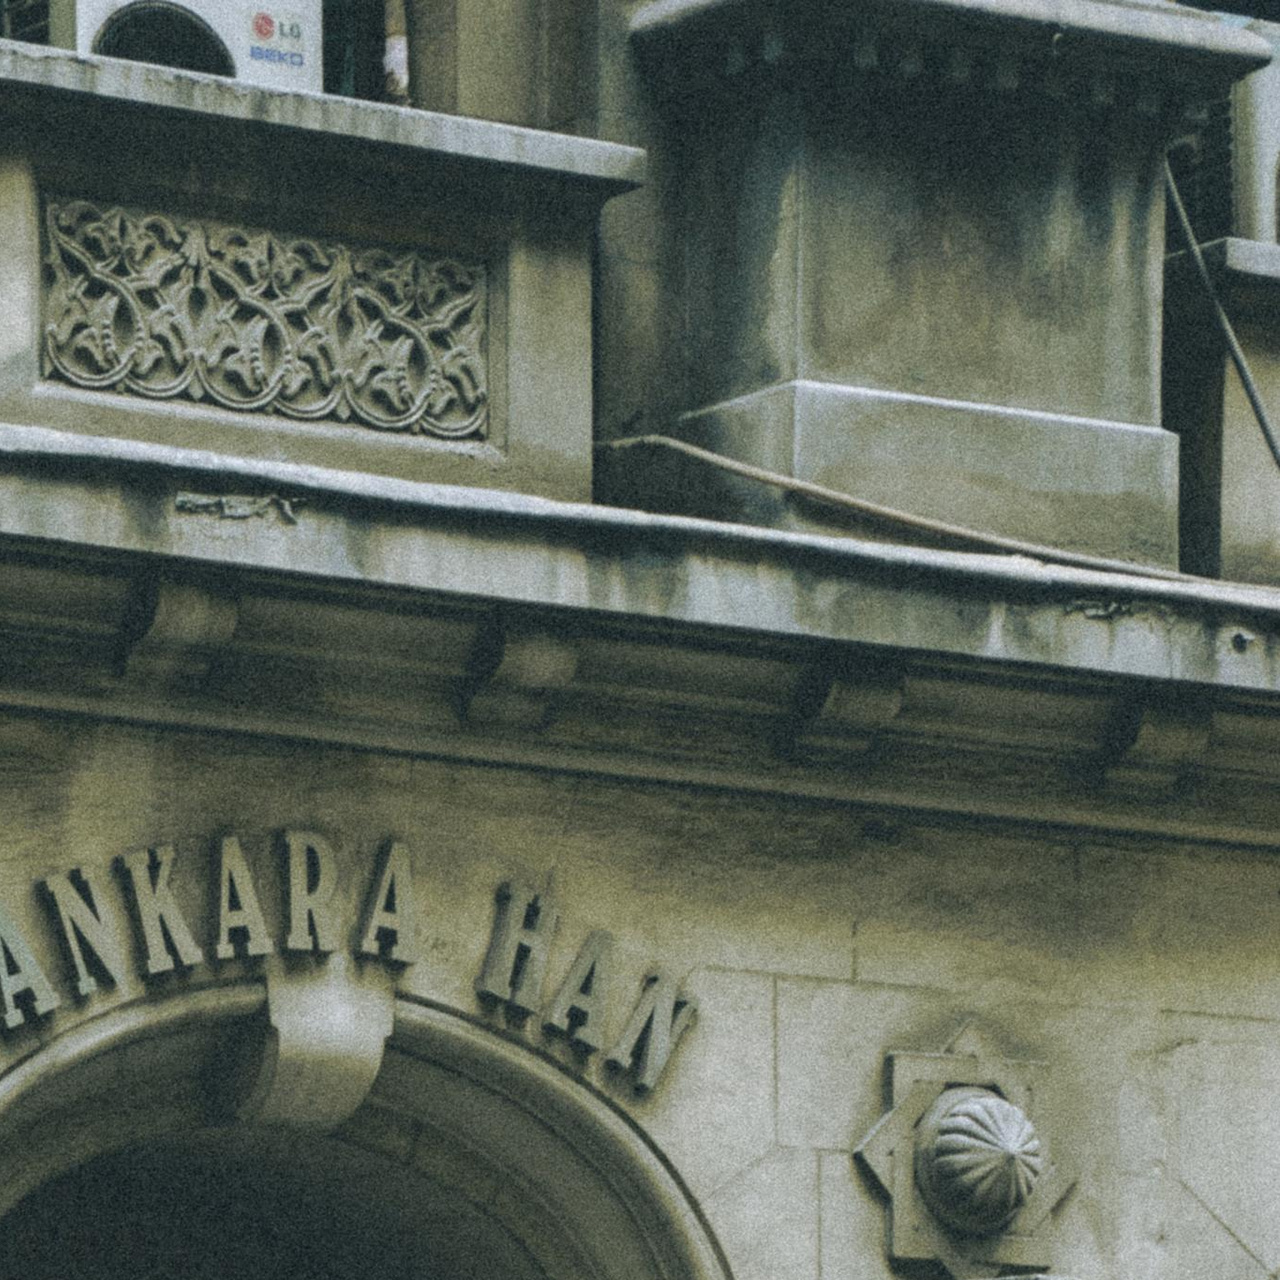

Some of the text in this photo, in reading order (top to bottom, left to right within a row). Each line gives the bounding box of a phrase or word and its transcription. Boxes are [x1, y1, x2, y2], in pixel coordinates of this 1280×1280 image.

[279, 21, 301, 39] LG
[250, 46, 304, 67] BEKO
[477, 872, 698, 1096] HAN
